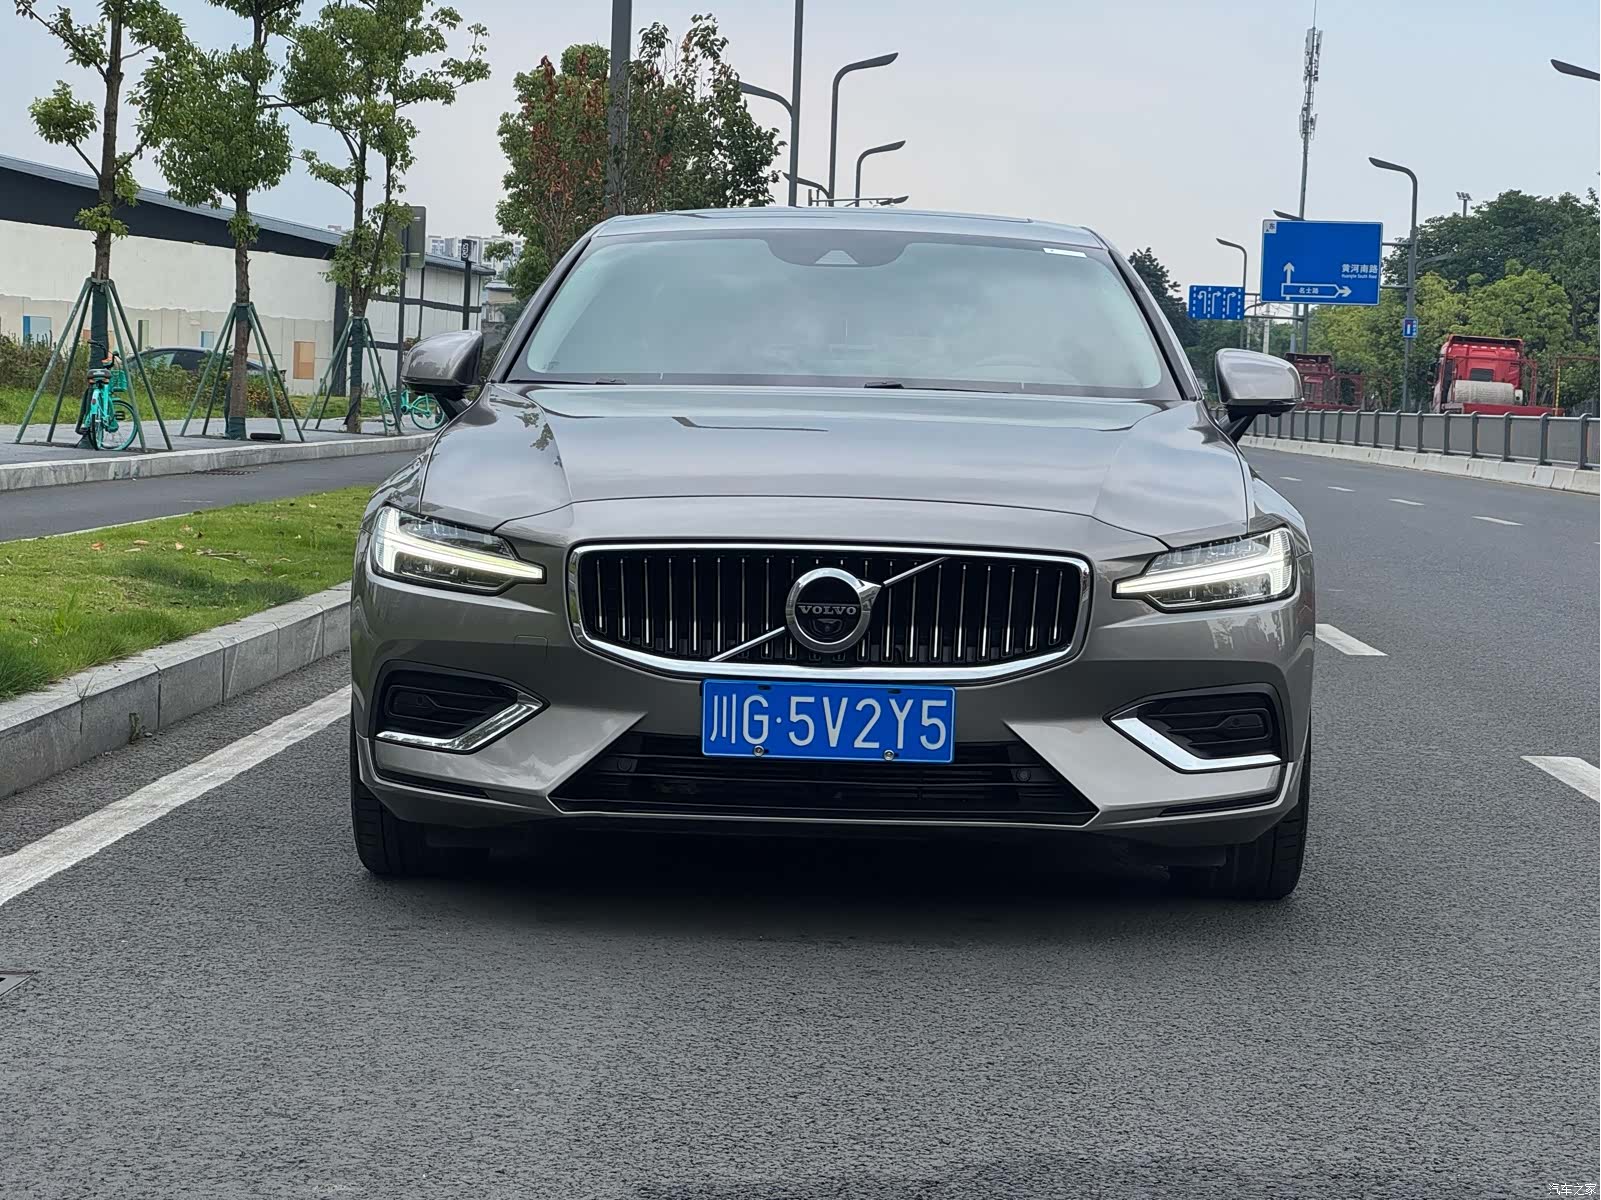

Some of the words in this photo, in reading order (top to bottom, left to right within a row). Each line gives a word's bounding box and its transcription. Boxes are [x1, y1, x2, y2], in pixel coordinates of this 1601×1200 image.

[1341, 263, 1378, 274] 黄河南路
[798, 605, 857, 615] VOLVO
[710, 693, 948, 750] 川G·5V2Y5
